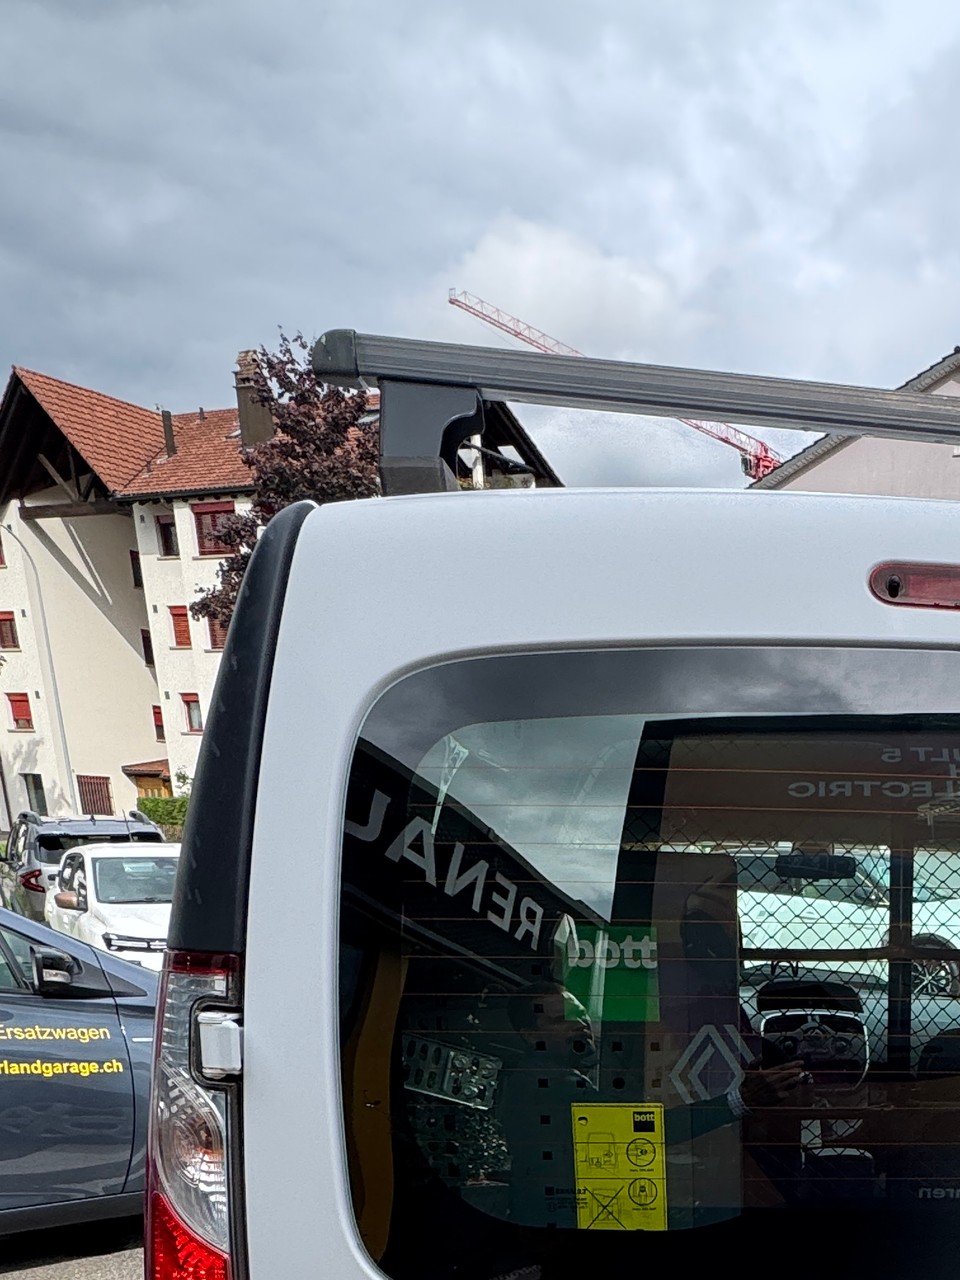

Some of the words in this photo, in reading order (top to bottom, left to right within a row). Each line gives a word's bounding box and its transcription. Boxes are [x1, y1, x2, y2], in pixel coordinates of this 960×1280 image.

[567, 933, 658, 969] bott
[0, 1024, 111, 1043] Ersatzwagen
[634, 1113, 656, 1122] bott
